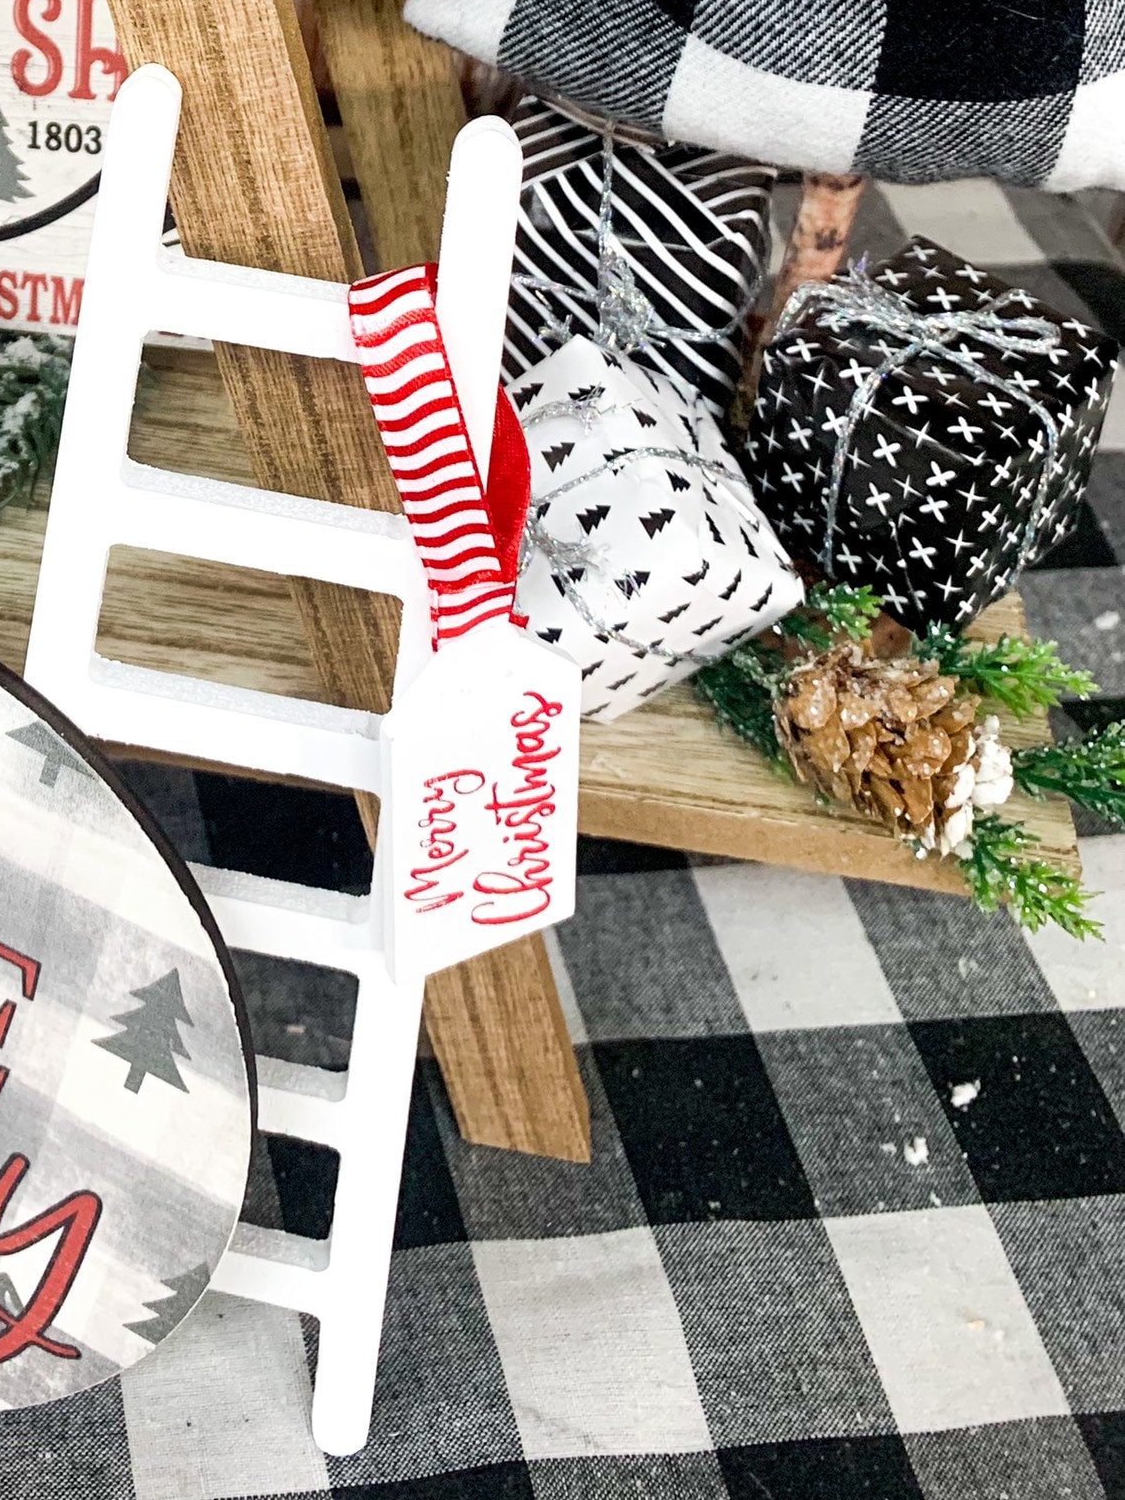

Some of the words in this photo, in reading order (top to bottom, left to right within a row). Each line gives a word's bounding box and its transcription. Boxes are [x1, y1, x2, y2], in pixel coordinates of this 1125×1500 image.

[26, 120, 103, 155] 1803
[403, 769, 486, 914] Merry
[470, 690, 564, 925] Christmas
